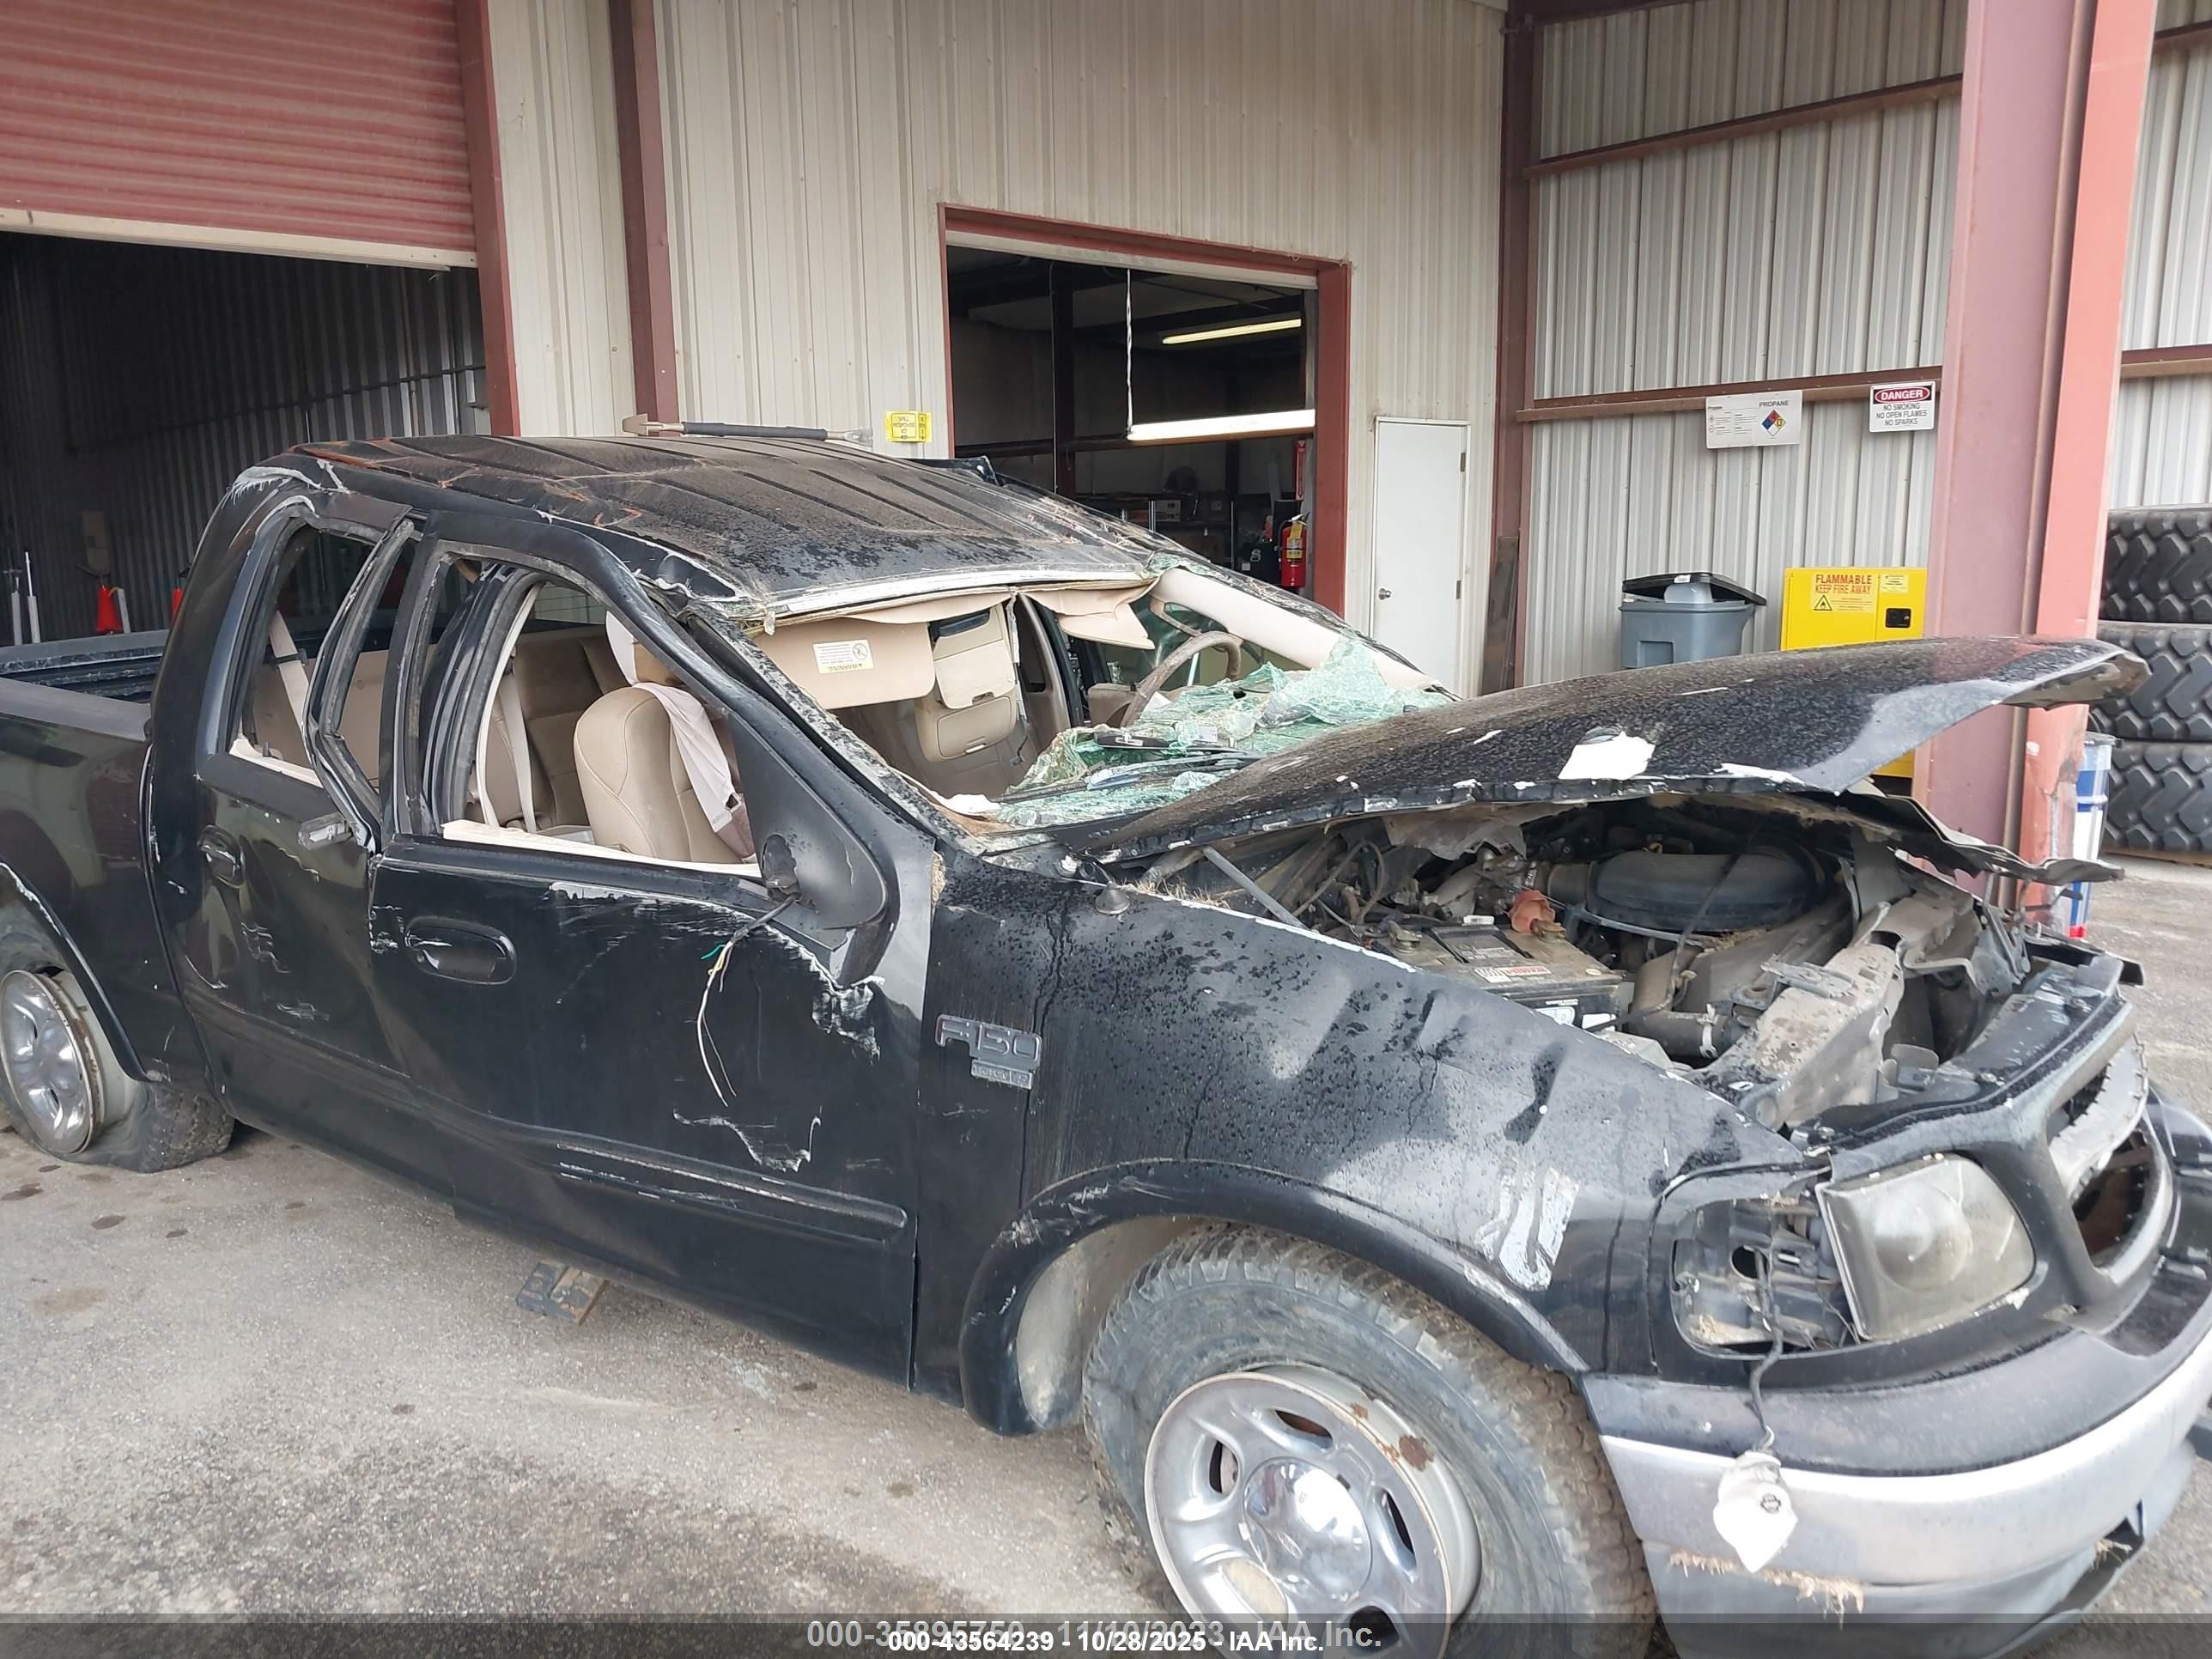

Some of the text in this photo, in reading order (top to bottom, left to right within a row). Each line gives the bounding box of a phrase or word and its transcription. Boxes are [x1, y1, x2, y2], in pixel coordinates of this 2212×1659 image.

[1881, 389, 1923, 401] DANGER
[1893, 402, 1921, 410] SMOKING
[1815, 574, 1872, 585] FLAMMABLE
[1815, 585, 1872, 594] KEEP FIRE AWAY
